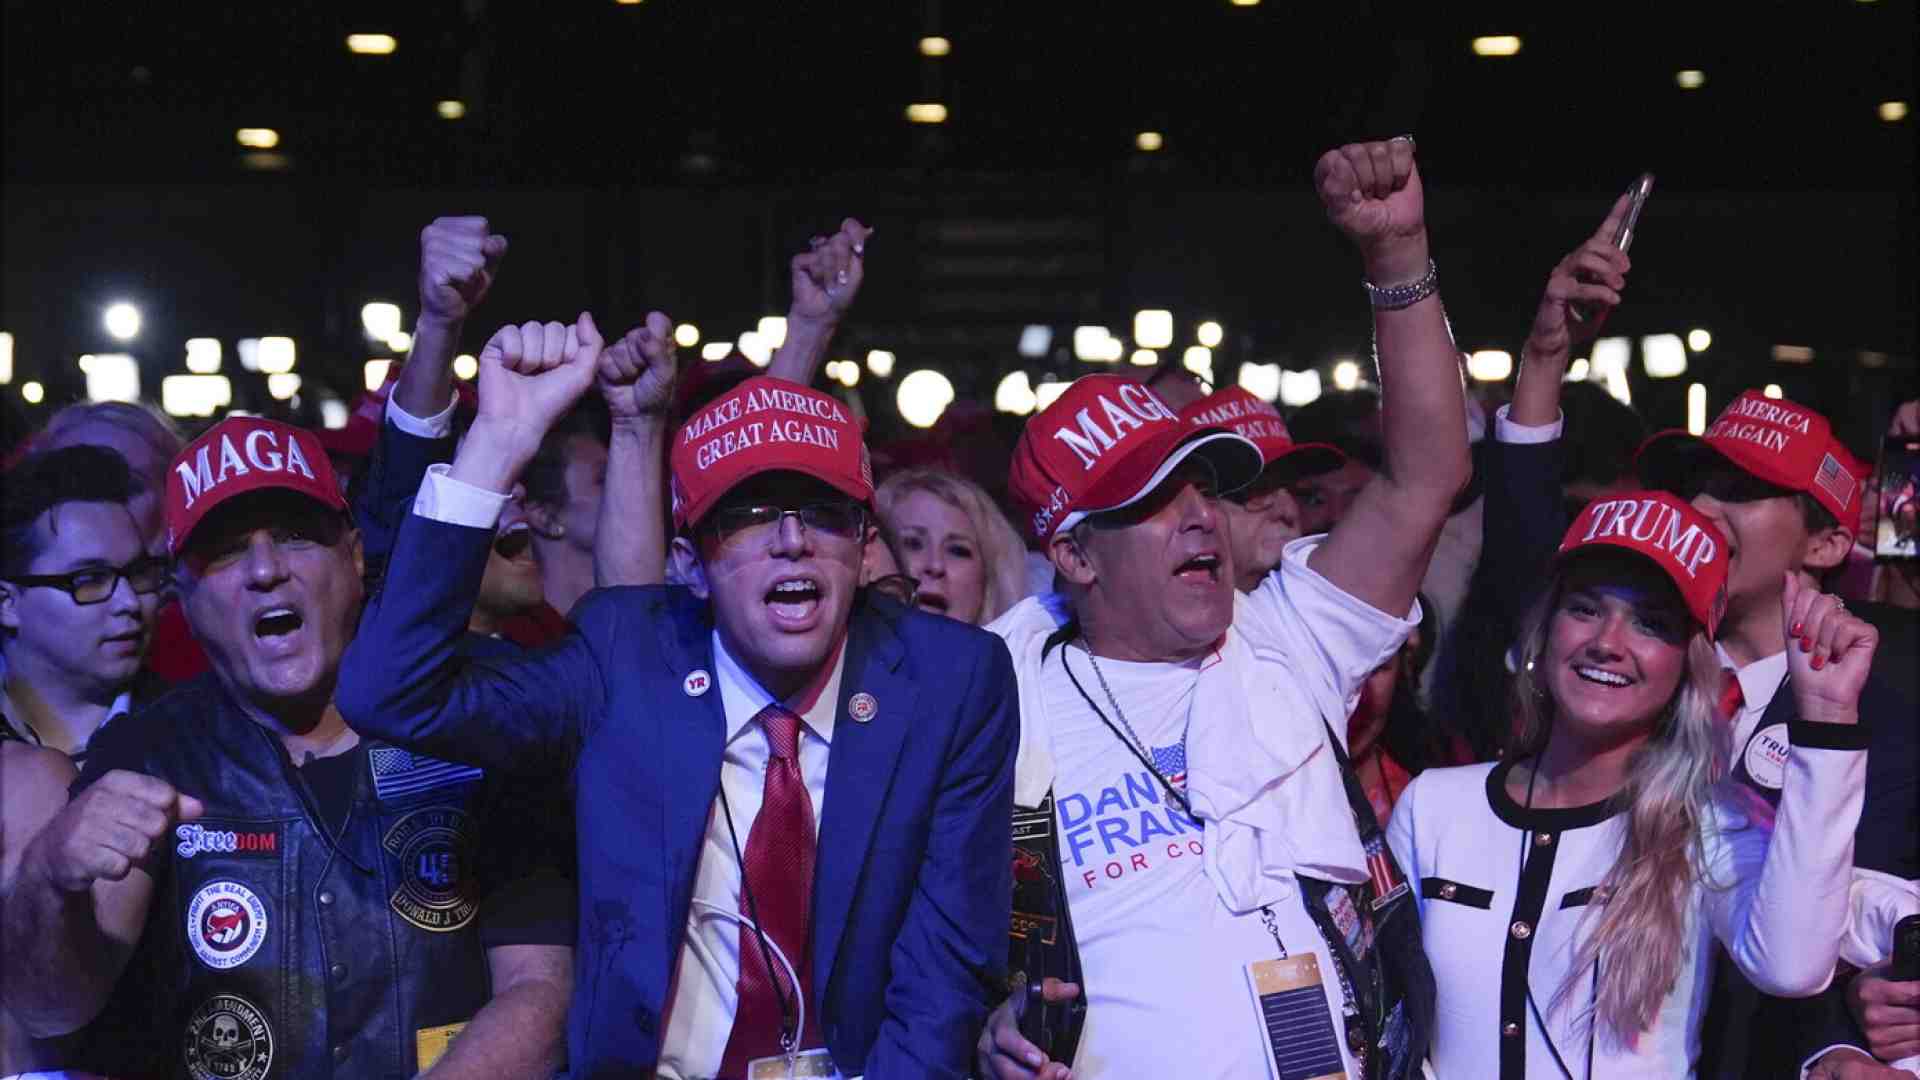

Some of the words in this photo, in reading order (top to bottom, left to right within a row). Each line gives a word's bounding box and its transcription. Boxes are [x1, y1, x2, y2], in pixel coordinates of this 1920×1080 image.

[683, 398, 743, 444] MAKE
[745, 388, 848, 424] AMERICA
[1191, 400, 1245, 425] MAKE
[697, 422, 765, 470] GREAT
[769, 420, 839, 450] AGAIN
[1727, 423, 1790, 453] AGAIN
[176, 429, 315, 510] MAGA
[1582, 499, 1716, 578] TRUMP
[1762, 736, 1789, 756] TRU
[1056, 772, 1161, 831] DAN
[1066, 808, 1205, 867] FRAN
[1083, 852, 1149, 889] FOR
[1167, 840, 1204, 859] CO
[224, 884, 247, 898] REAL
[397, 894, 440, 926] DONALD
